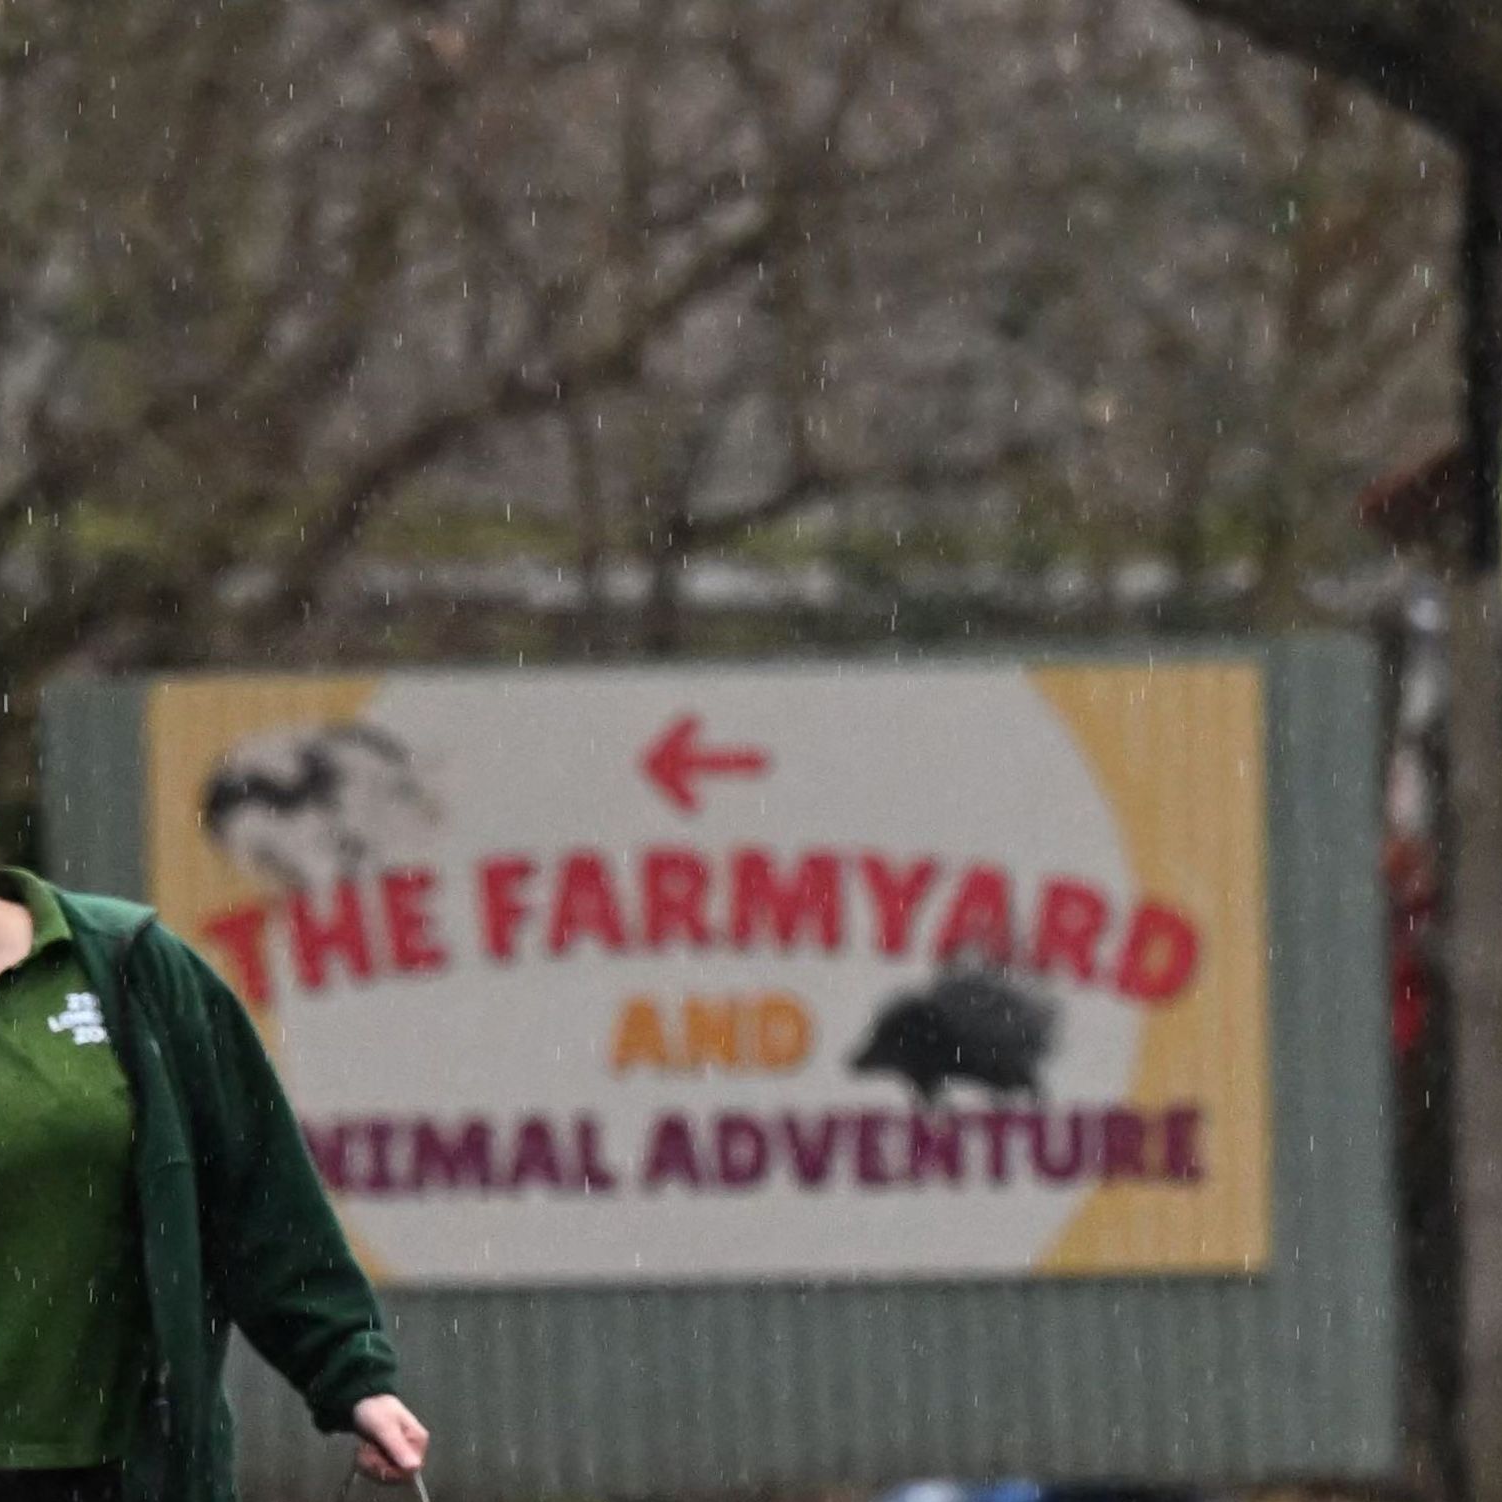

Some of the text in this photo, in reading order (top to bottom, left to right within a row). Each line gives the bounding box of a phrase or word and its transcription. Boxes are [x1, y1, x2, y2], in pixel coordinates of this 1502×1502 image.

[202, 847, 1205, 1008] THE FARMYARD
[612, 995, 813, 1072] AND
[302, 1106, 1205, 1192] NIMAL ADVENTURE
